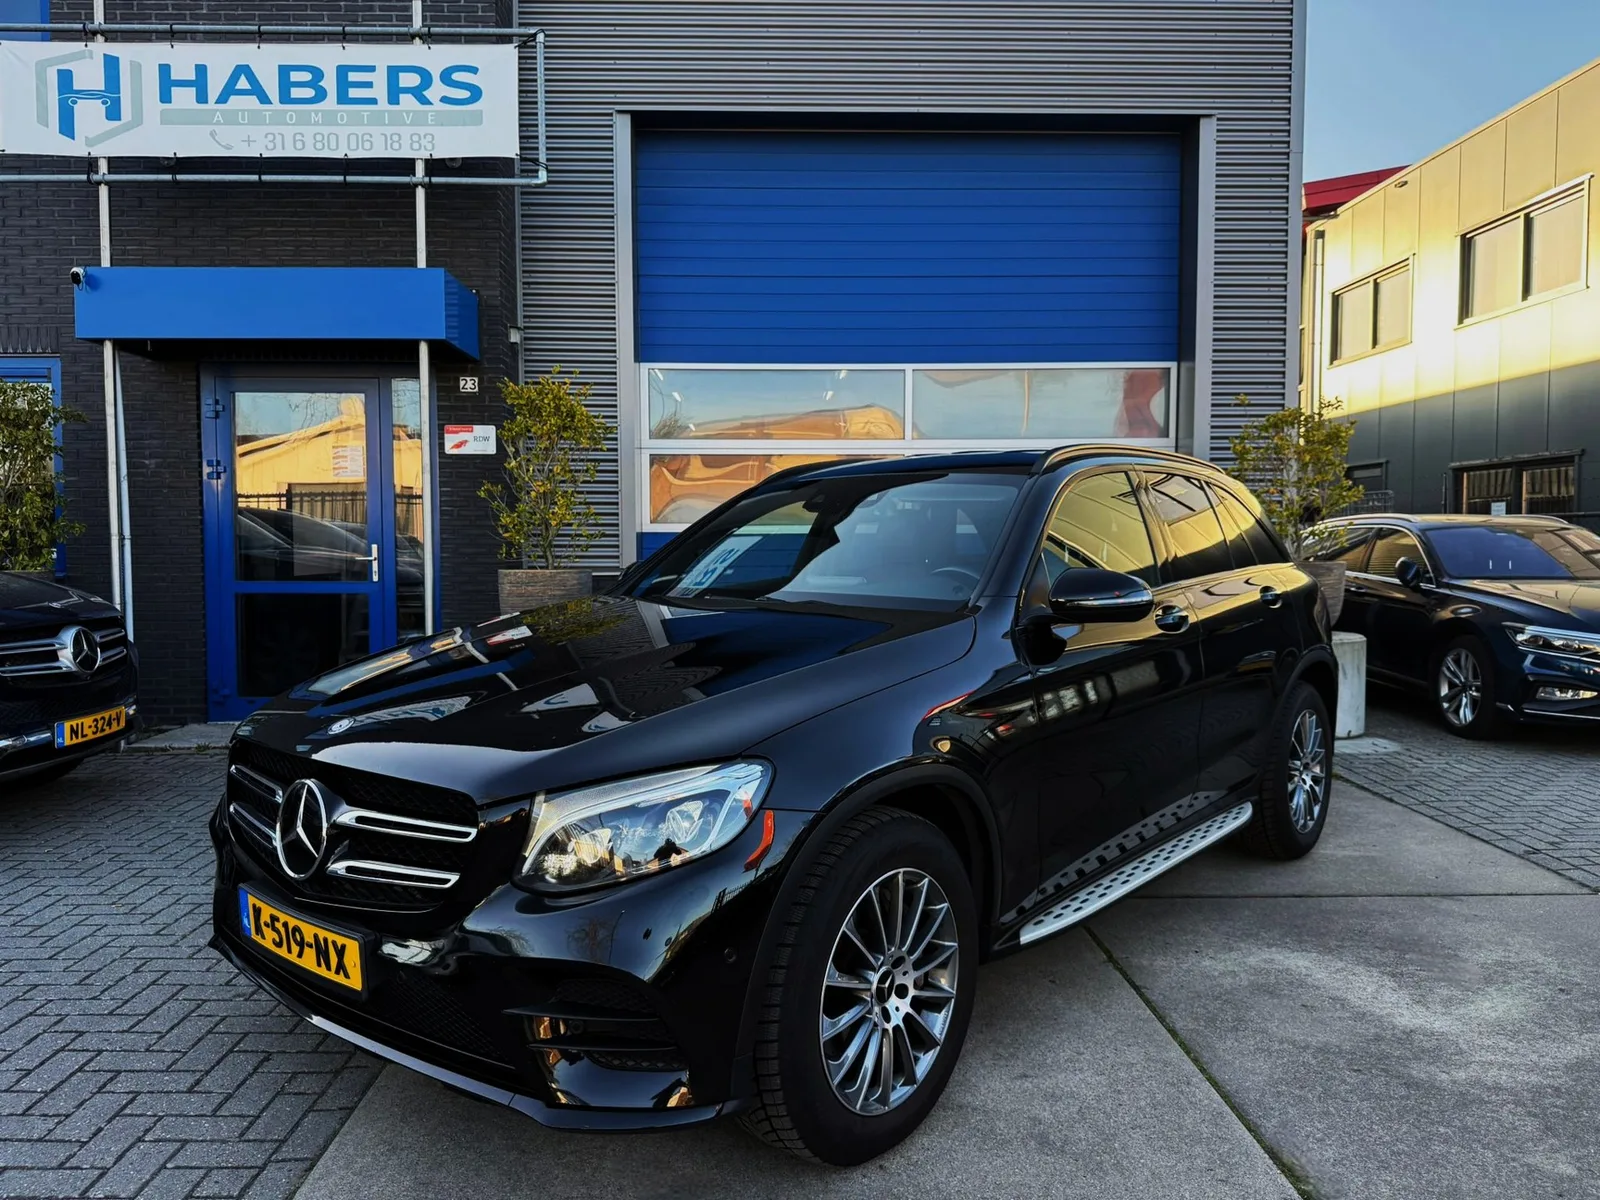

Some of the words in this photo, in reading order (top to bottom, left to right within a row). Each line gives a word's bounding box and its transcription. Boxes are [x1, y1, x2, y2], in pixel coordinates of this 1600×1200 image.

[158, 63, 483, 106] HABERS
[213, 111, 436, 125] AUTOMOTIVE
[312, 132, 339, 151] 80
[347, 132, 374, 151] 06
[380, 132, 402, 151] 18
[409, 132, 436, 151] 83
[460, 378, 477, 390] 23
[69, 710, 122, 741] NL-324-V
[251, 902, 351, 980] K-519-NX
